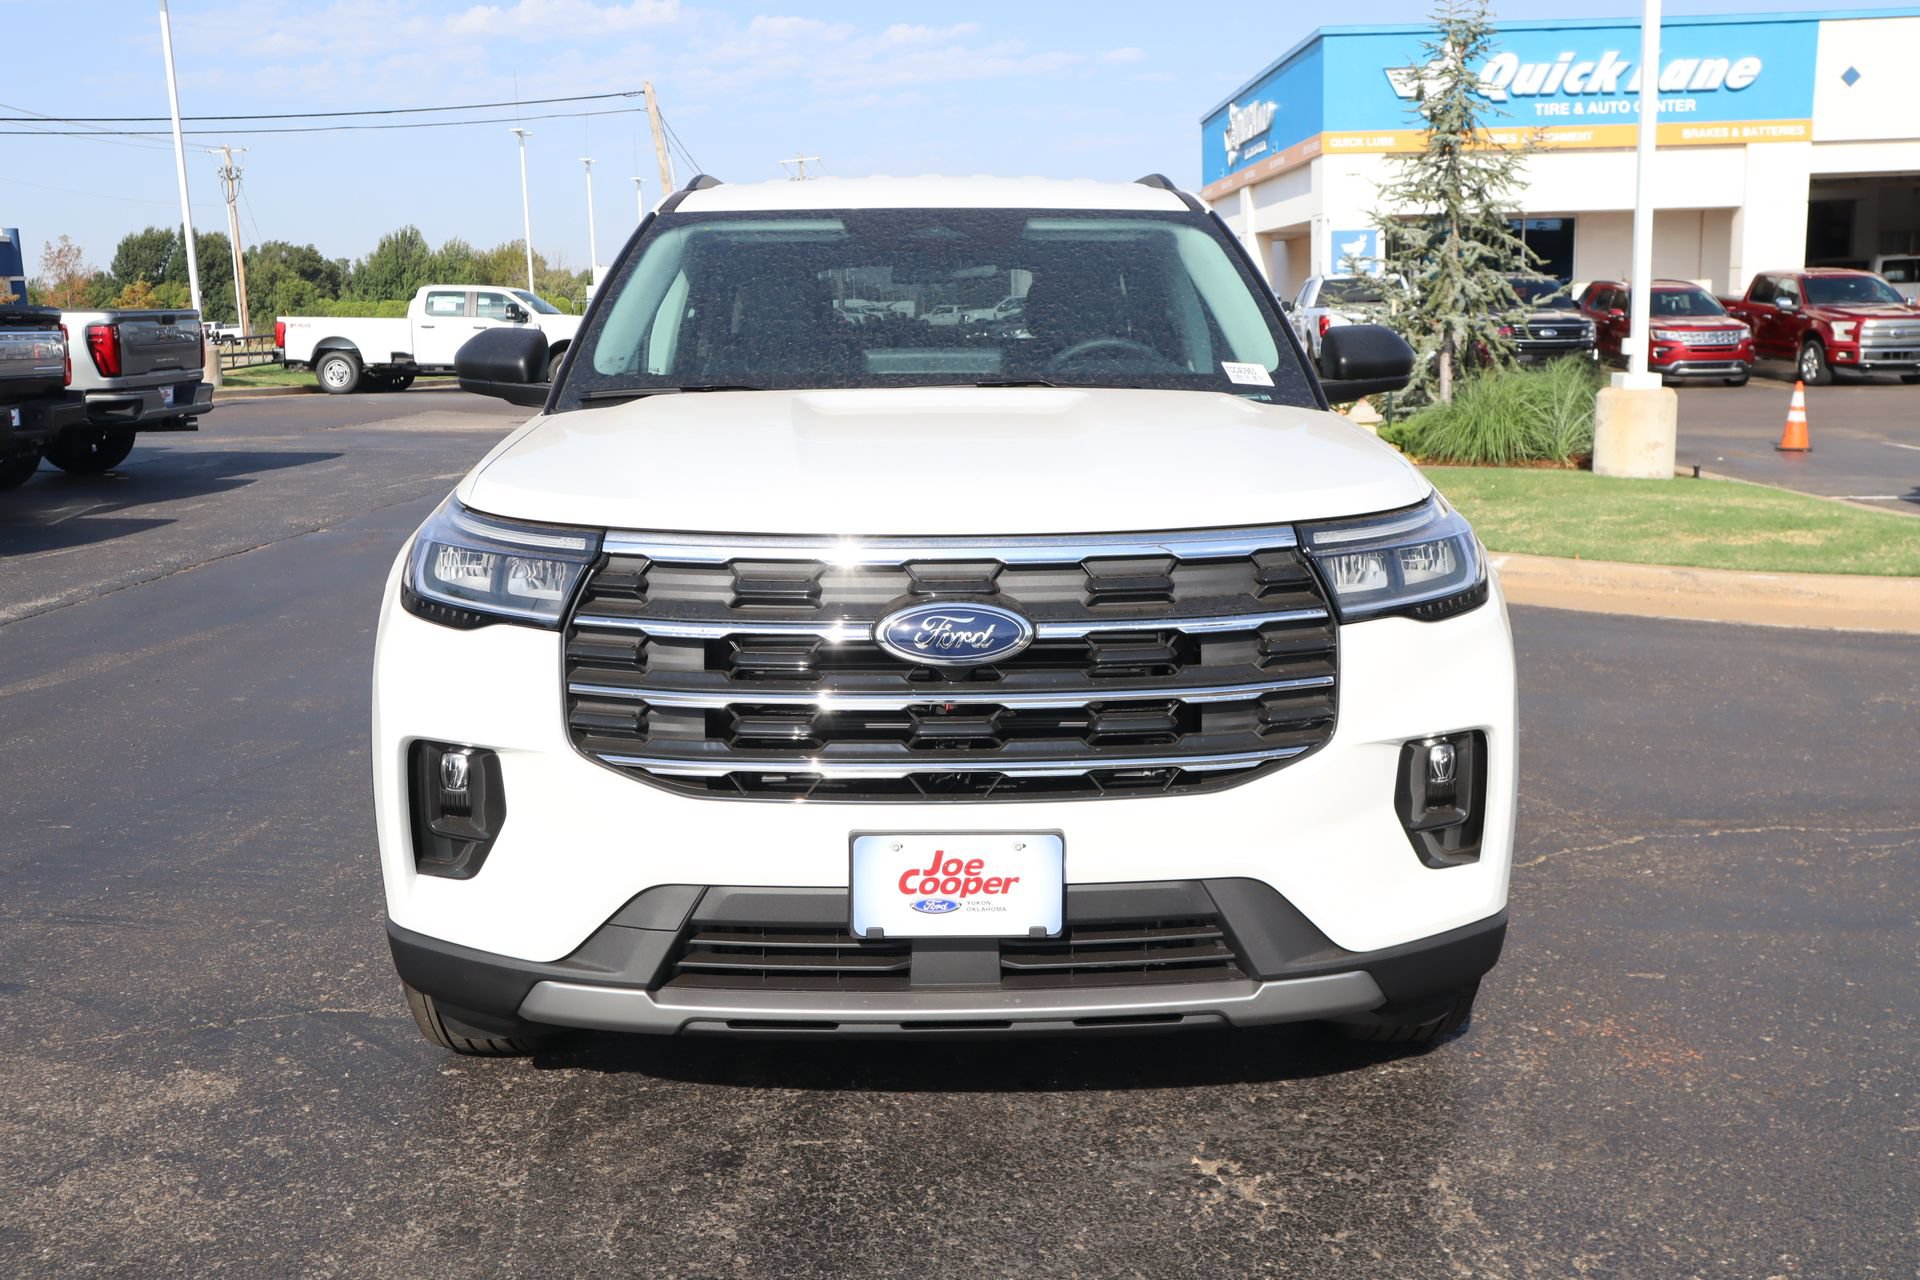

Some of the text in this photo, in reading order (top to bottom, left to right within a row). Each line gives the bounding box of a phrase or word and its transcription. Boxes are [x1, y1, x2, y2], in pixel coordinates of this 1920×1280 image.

[1477, 50, 1631, 101] Quick
[1535, 98, 1697, 116] TIRE & AUTO CNTER
[1330, 137, 1364, 148] QUICK
[1366, 136, 1396, 147] LUBE
[1682, 125, 1806, 139] BRAKES & BATTERIES
[913, 615, 997, 650] Ford
[922, 850, 985, 877] Joe
[898, 868, 1020, 898] Cooper
[922, 899, 949, 911] Ford
